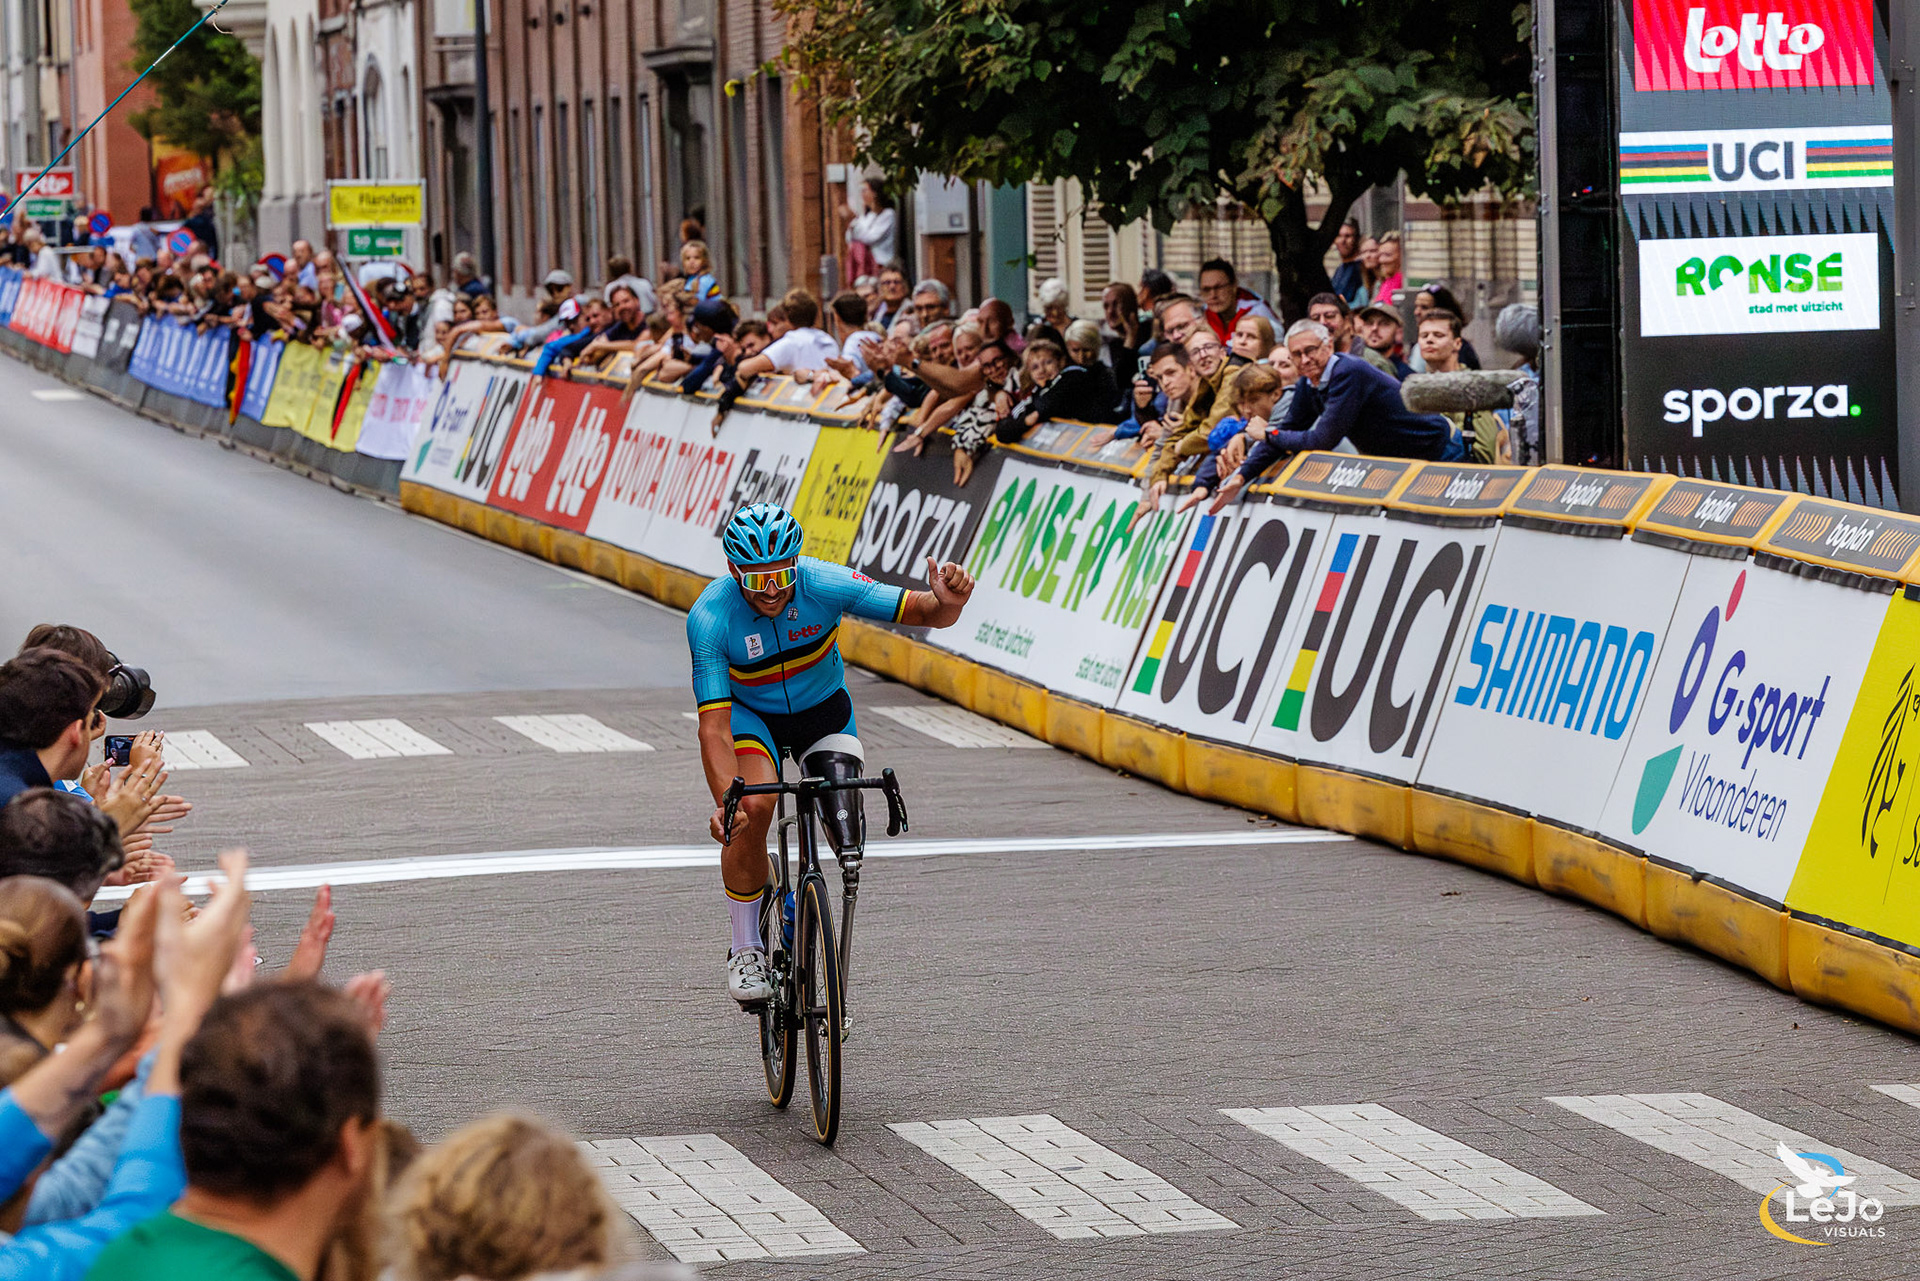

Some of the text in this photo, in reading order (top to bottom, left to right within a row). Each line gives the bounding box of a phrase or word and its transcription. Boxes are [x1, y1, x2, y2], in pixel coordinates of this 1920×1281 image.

[1683, 8, 1825, 73] lotto
[1712, 140, 1795, 181] UCI
[1675, 252, 1843, 296] RONSE
[1748, 300, 1843, 314] stad met uitzicht
[606, 428, 673, 511] TOYOTA
[658, 441, 736, 530] TOYOTA
[1695, 488, 1742, 529] boplan
[966, 476, 1093, 604] RONSE
[1061, 498, 1188, 630] RONSE
[1825, 515, 1879, 557] boplan
[1160, 517, 1317, 724] UCI
[1309, 534, 1486, 759] UCI
[1454, 604, 1656, 741] SHIMANO
[1679, 753, 1790, 843] Vlaanderen
